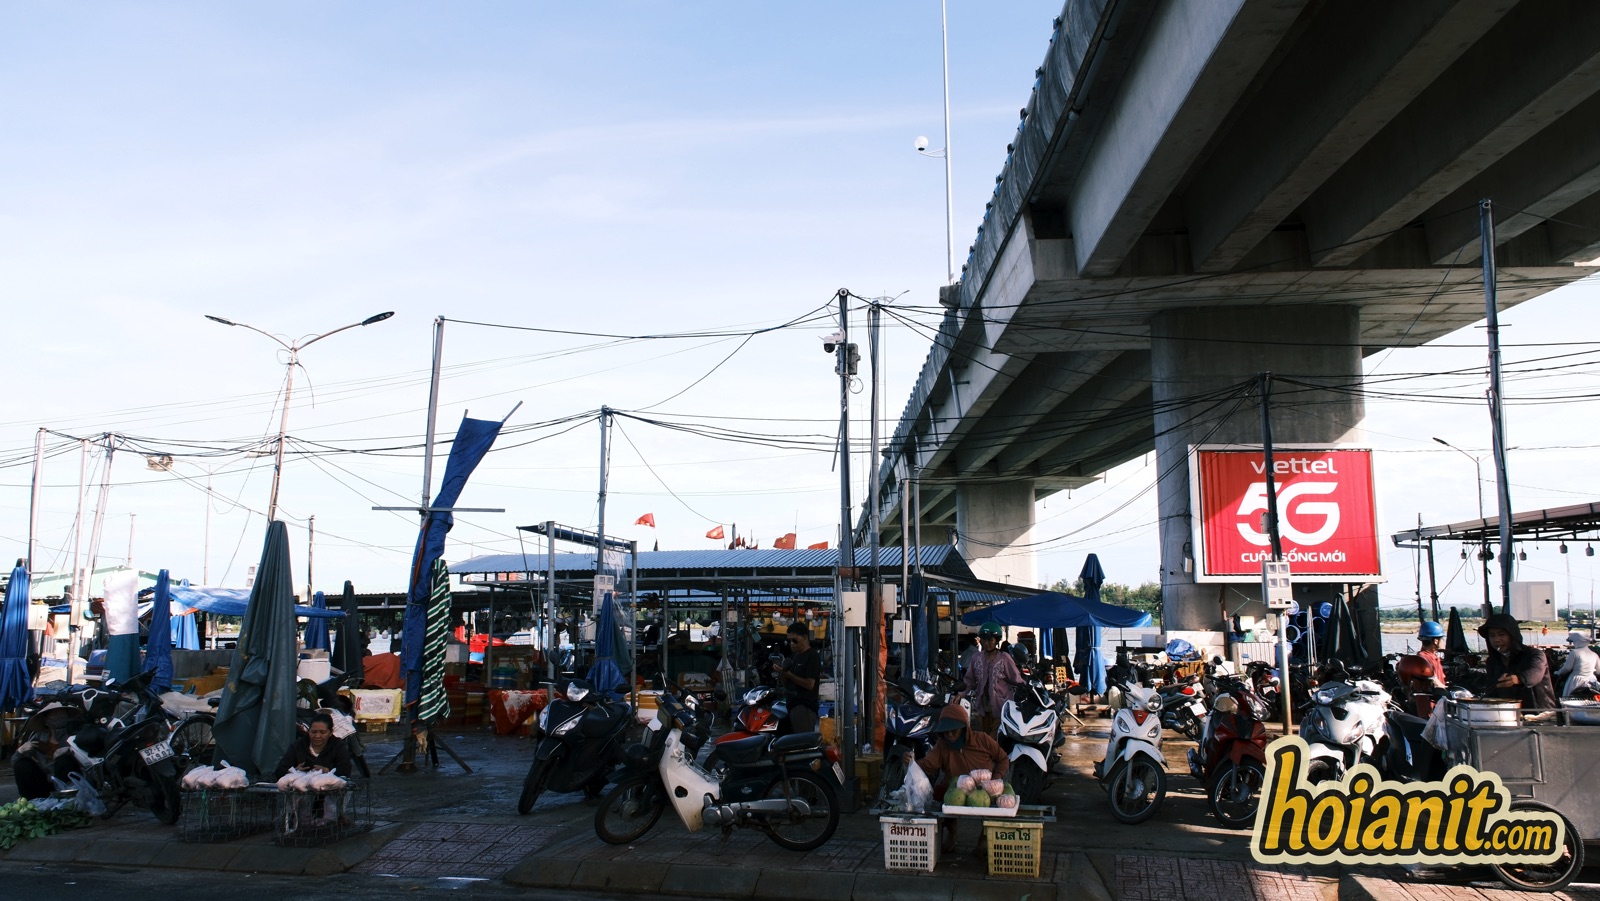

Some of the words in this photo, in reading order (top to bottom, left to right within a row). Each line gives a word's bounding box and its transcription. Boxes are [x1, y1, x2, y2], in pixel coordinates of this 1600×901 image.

[1250, 457, 1338, 474] vettel
[1236, 481, 1341, 546] 5G
[1320, 549, 1346, 562] MỚI
